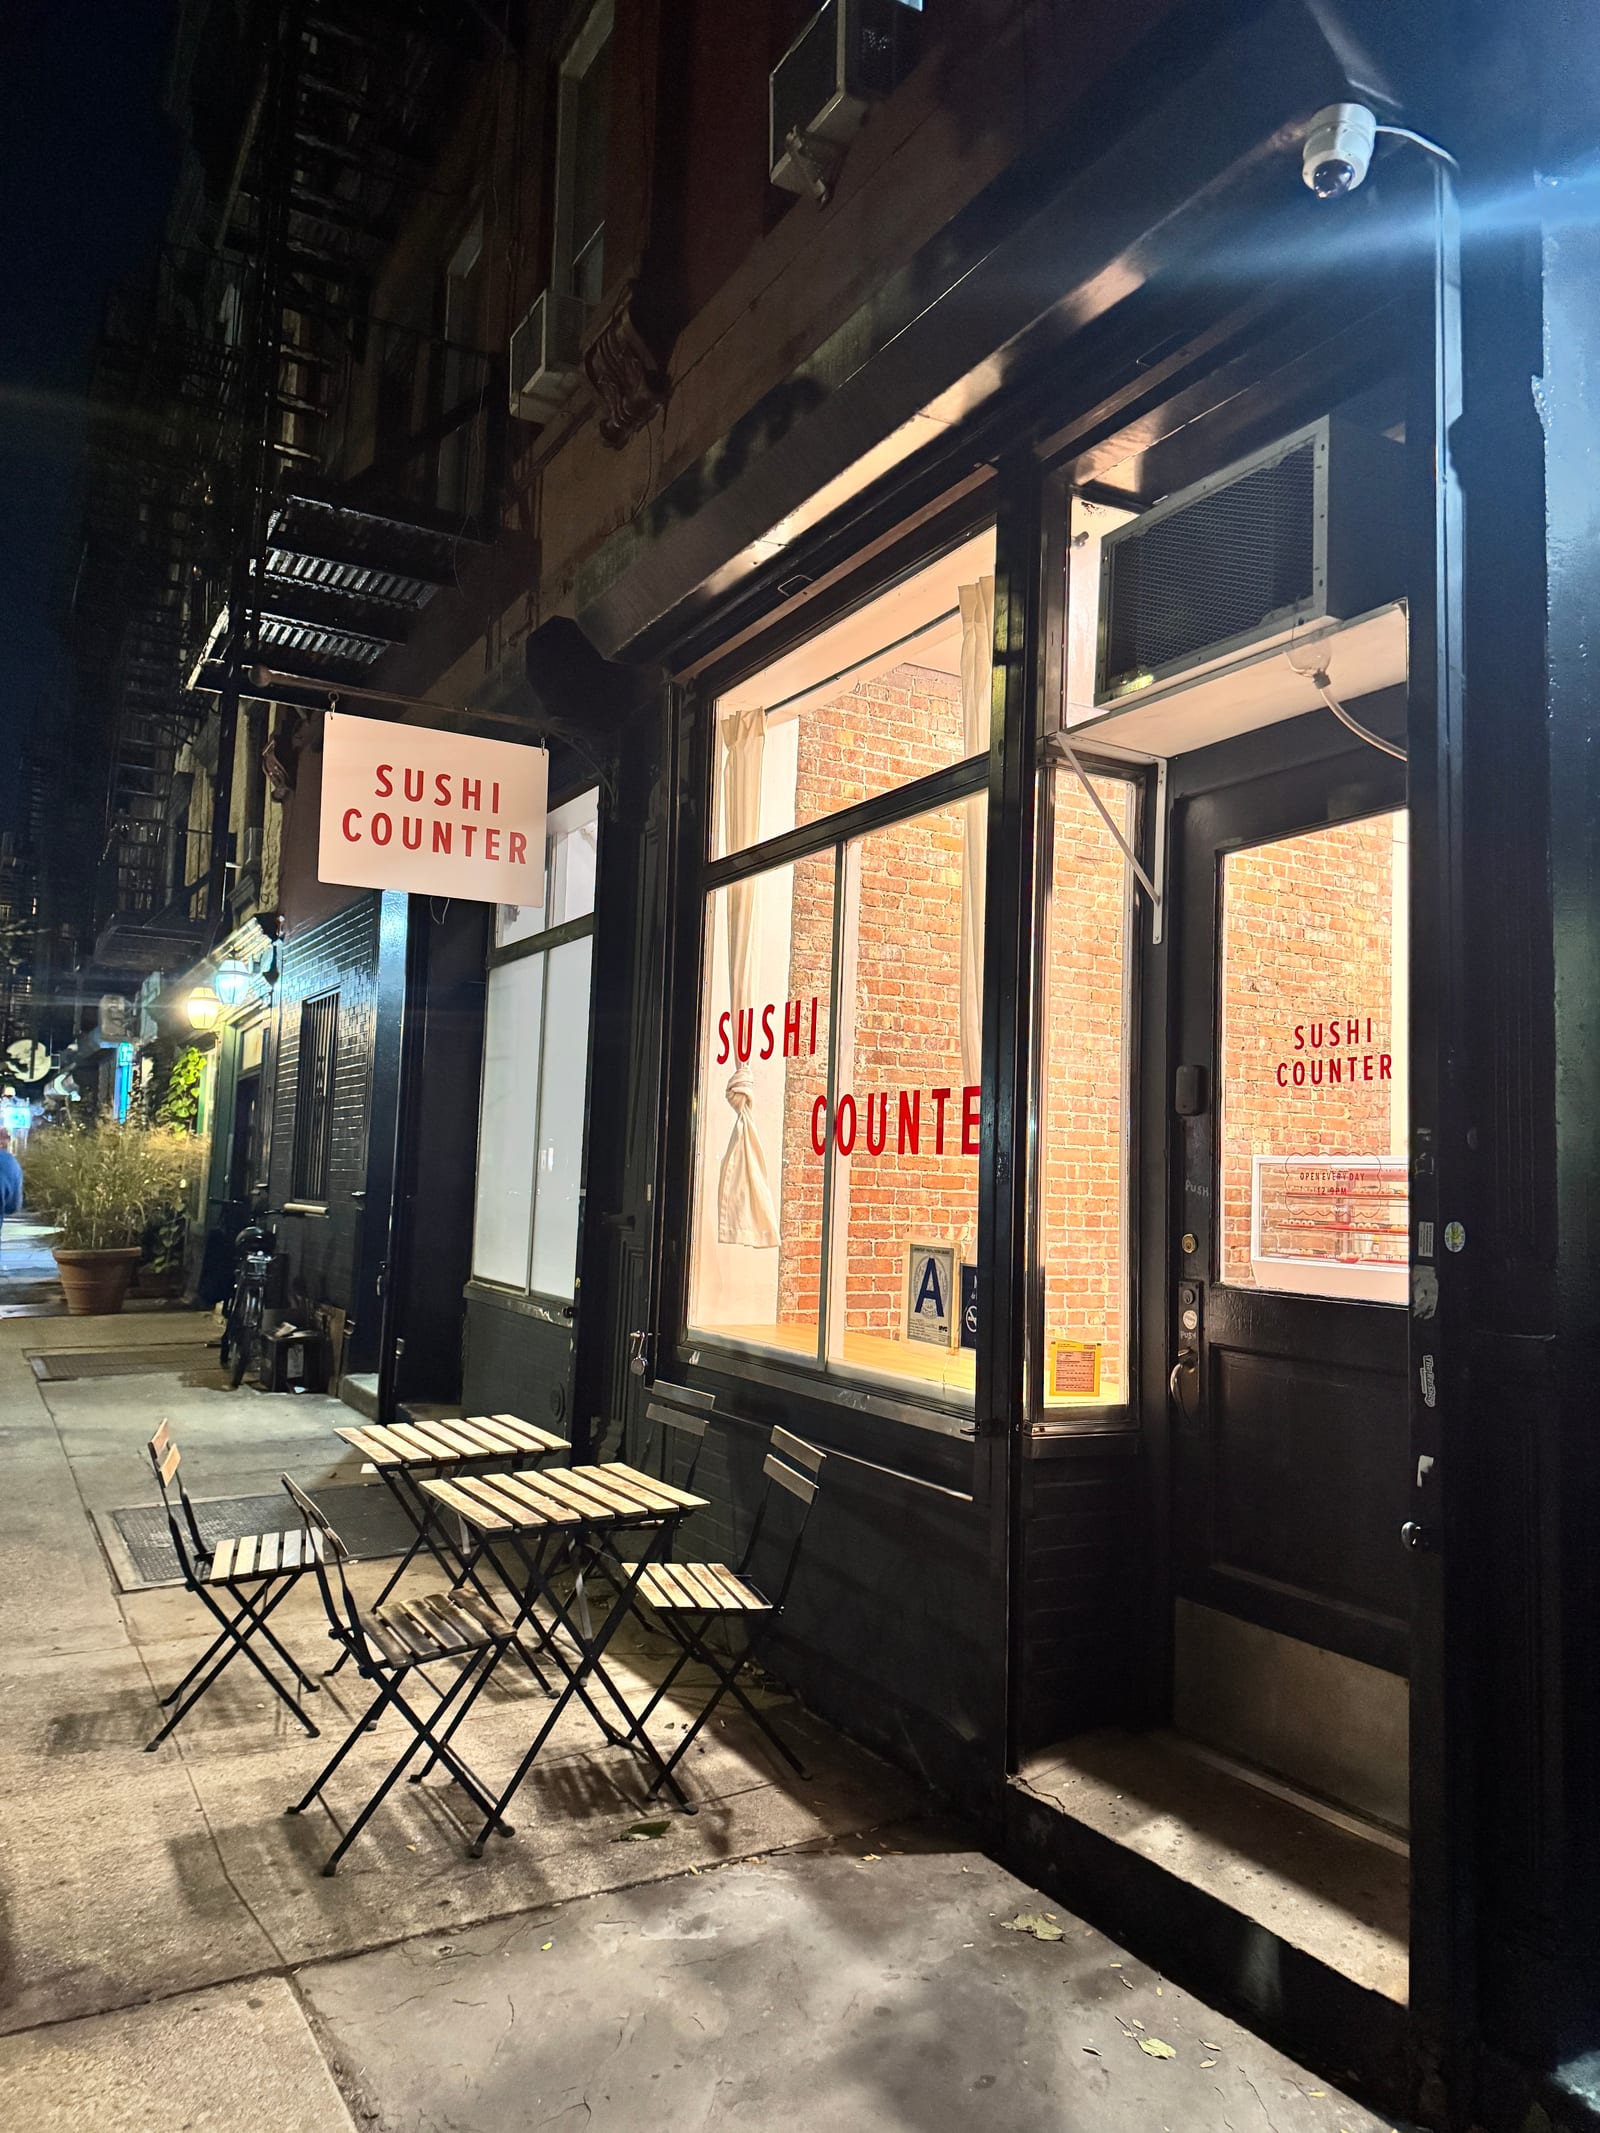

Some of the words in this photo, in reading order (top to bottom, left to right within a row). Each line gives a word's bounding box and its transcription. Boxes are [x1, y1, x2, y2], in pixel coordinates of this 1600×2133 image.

[375, 764, 499, 814] SUSHI
[342, 808, 527, 865] COUNTER
[717, 997, 818, 1065] SUSHI
[1294, 1017, 1371, 1050] SUSHI
[1276, 1054, 1392, 1087] COUNTER
[811, 1086, 981, 1157] COUNTE
[1185, 1179, 1209, 1197] PUSH
[1300, 1172, 1320, 1181] OPEN
[1322, 1172, 1346, 1181] EVERY
[1349, 1172, 1365, 1181] DAY
[914, 1257, 944, 1318] A
